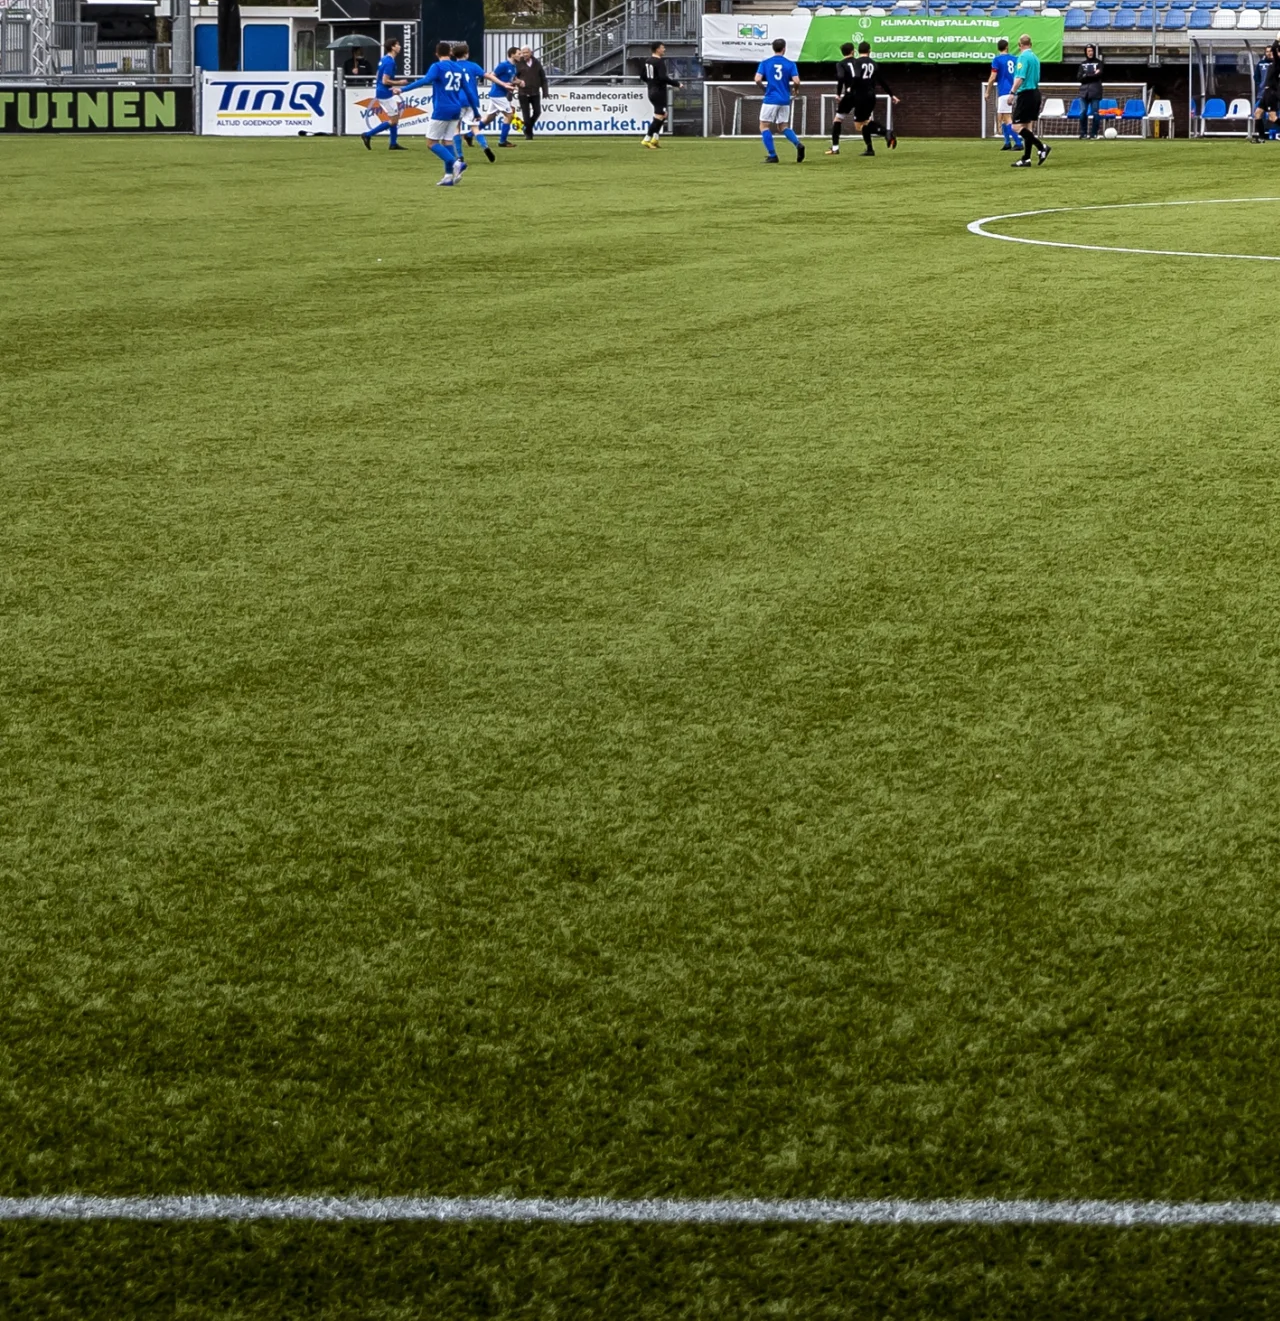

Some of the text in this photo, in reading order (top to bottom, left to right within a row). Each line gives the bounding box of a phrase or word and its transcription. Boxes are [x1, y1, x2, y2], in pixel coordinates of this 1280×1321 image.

[881, 19, 999, 28] KLIMAATINSTALLATIES
[873, 35, 934, 43] DUURZAME
[928, 51, 995, 59] ONDERHOUD
[773, 64, 783, 80] 3
[861, 63, 874, 79] 29
[1007, 60, 1014, 74] 8
[445, 71, 462, 91] 23
[569, 92, 643, 100] Raamdecoraties
[556, 104, 591, 112] Vloeren
[602, 104, 628, 114] Tapijt
